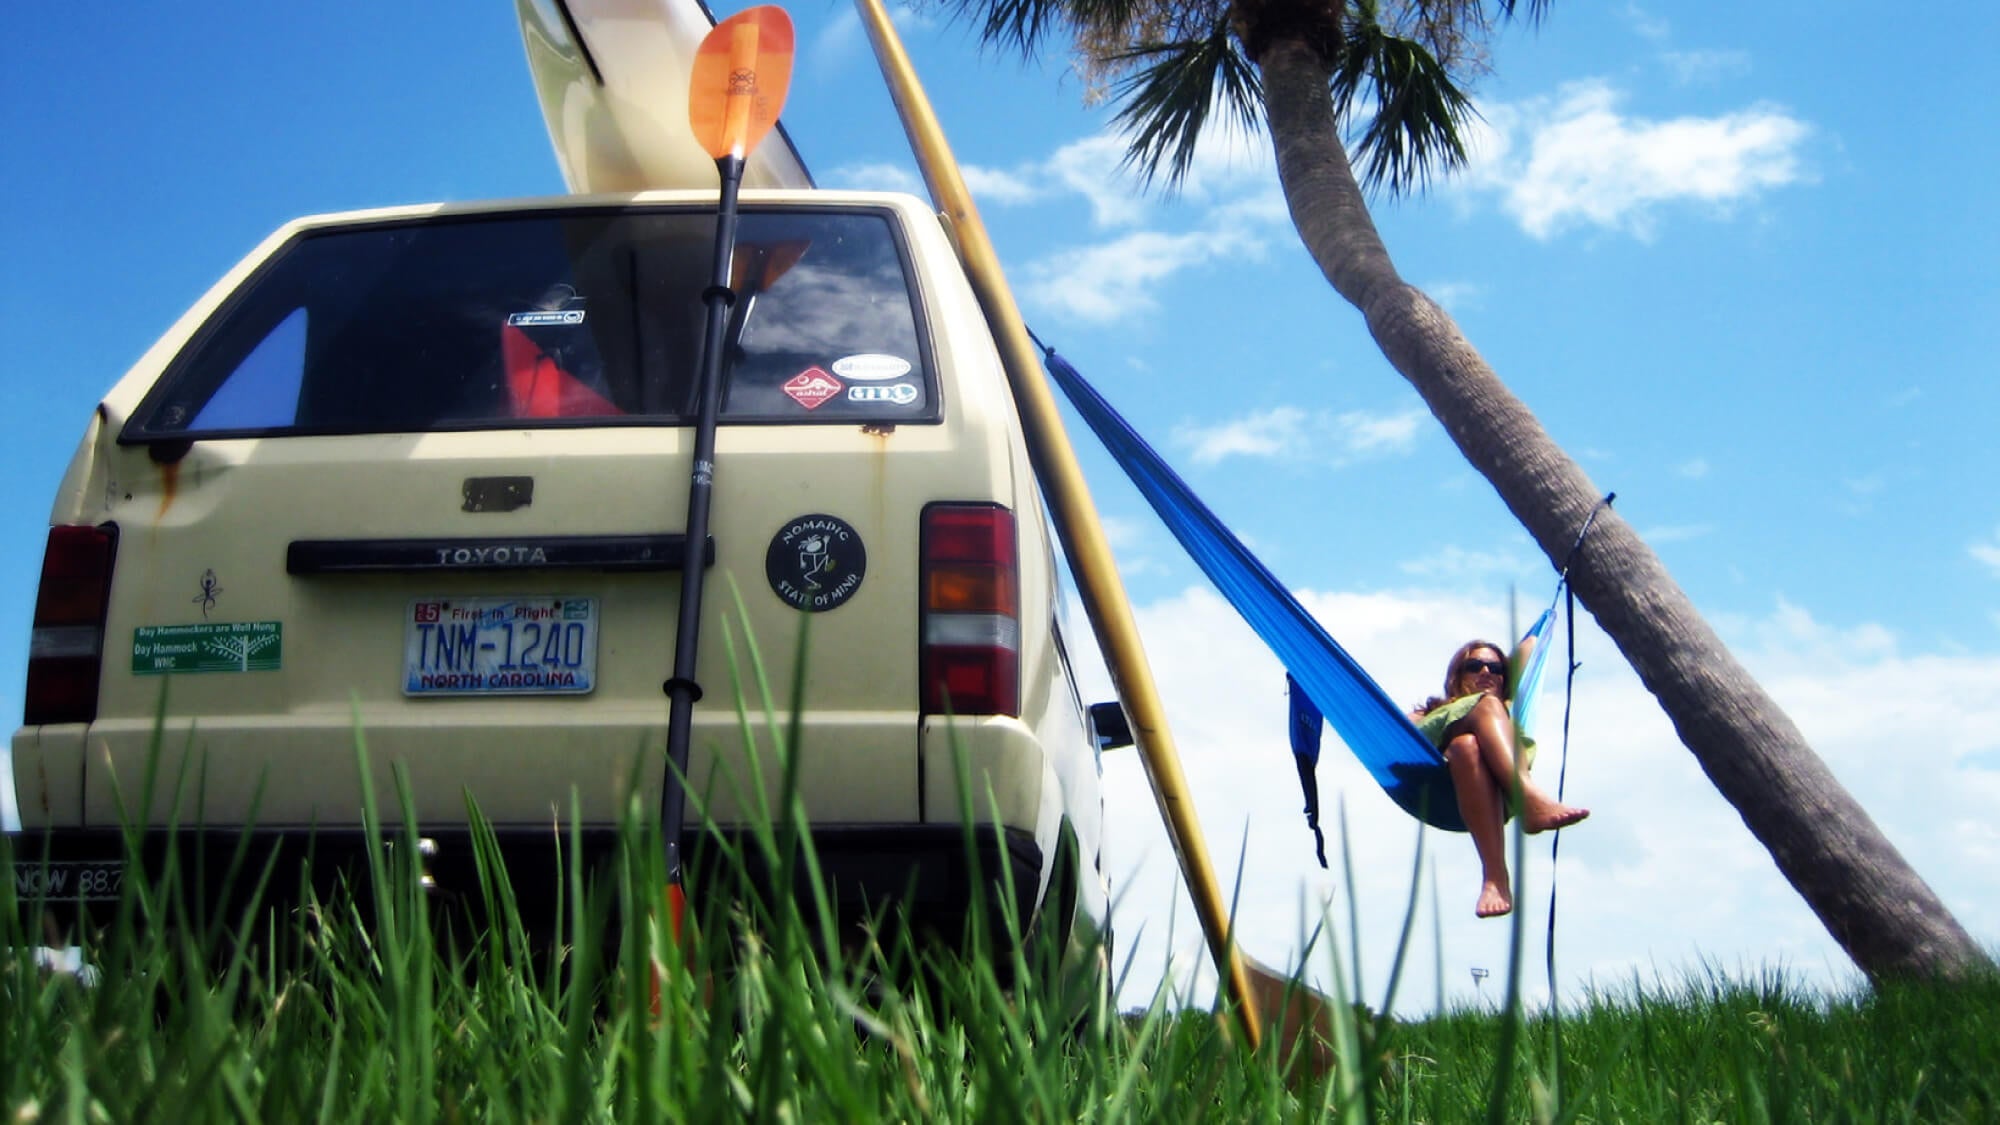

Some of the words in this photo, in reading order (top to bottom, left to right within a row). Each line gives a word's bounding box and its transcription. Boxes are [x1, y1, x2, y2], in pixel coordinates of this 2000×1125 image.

[783, 520, 849, 545] NOMADIC
[437, 548, 547, 564] TOYOTA
[814, 594, 829, 606] OF
[831, 574, 857, 601] MIND
[452, 607, 483, 620] First
[515, 606, 555, 621] Flight
[139, 628, 155, 638] Day
[157, 624, 213, 635] Hammockers
[216, 624, 230, 633] are
[232, 622, 250, 632] Well
[253, 622, 276, 632] Hung
[134, 644, 151, 657] Day
[153, 641, 198, 654] Hammock
[416, 622, 585, 671] TNM-1240
[154, 656, 177, 669] WNC
[421, 674, 482, 689] NORTH
[489, 672, 575, 688] CAROLINA
[80, 869, 124, 893] 88.7
